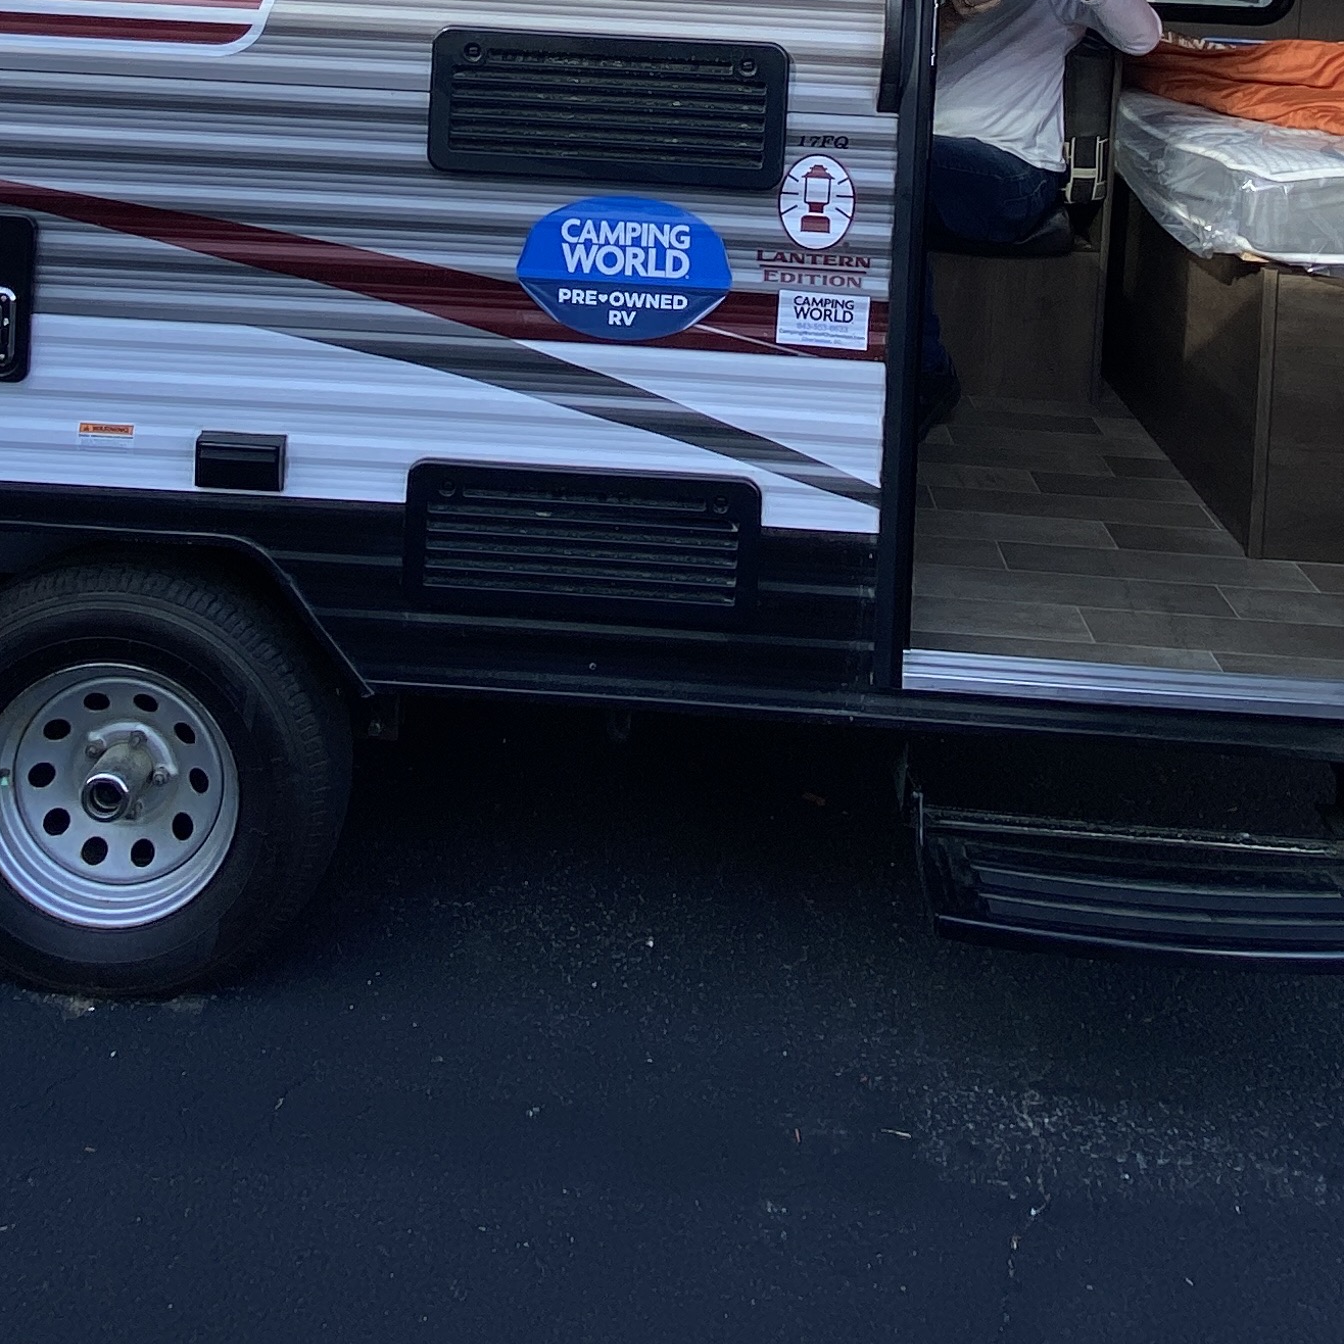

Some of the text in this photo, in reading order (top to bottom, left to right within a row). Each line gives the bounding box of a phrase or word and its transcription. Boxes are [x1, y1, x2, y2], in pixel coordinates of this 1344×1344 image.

[796, 135, 850, 150] 17FQ
[561, 218, 691, 249] CAMPING
[561, 243, 690, 279] WORLD
[756, 249, 871, 269] LANTERN
[763, 269, 862, 288] EDITION
[793, 295, 855, 310] CAMPING
[608, 310, 637, 326] RV
[793, 306, 854, 323] WORLD
